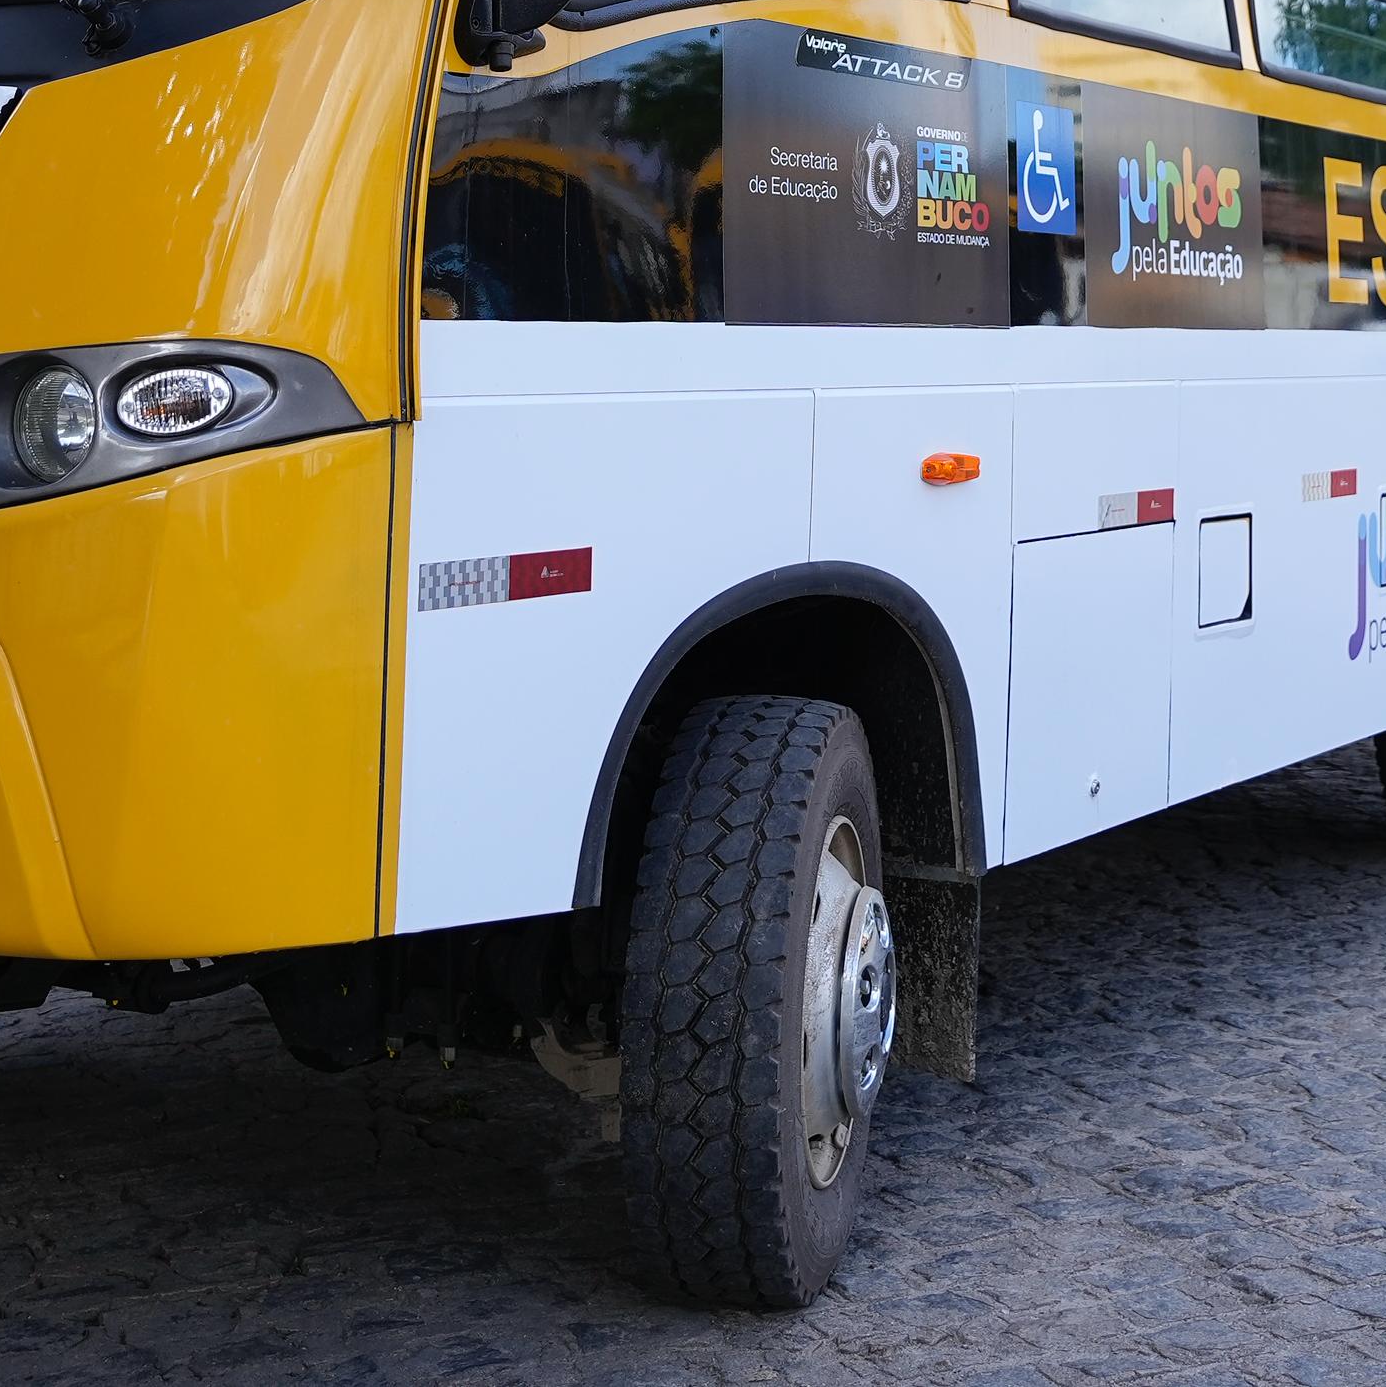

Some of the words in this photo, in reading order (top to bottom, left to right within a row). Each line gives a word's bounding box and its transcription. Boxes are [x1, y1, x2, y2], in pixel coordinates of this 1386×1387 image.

[805, 34, 847, 53] Volare
[831, 53, 939, 86] ATTACK
[944, 72, 965, 89] 8
[916, 126, 961, 142] GOVERNO
[770, 146, 838, 171] Secretaria
[916, 141, 969, 173] PER
[749, 175, 768, 194] de
[771, 176, 838, 203] Educação
[917, 169, 977, 202] NAM
[917, 199, 990, 232] BUCO
[1112, 140, 1242, 275] juntos
[917, 232, 945, 245] ESTADO
[945, 234, 956, 246] DE
[956, 235, 990, 248] MUDANÇA
[1132, 238, 1167, 282] pela
[1170, 240, 1243, 286] Educação
